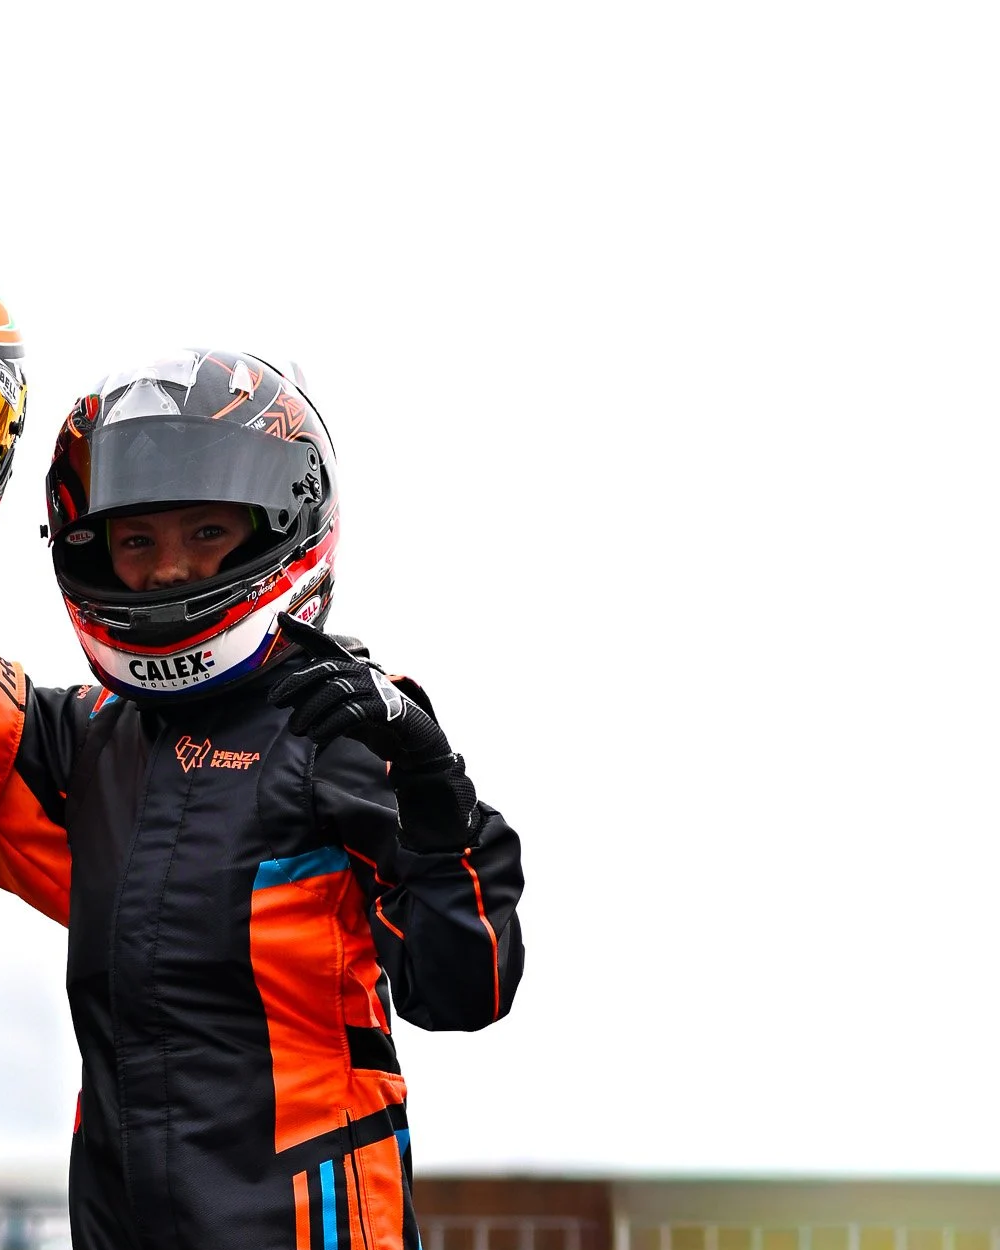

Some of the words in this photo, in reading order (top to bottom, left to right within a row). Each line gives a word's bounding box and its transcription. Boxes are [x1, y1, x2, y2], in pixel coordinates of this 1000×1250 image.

[0, 370, 17, 401] BELL
[128, 650, 208, 681] CALEX
[140, 672, 211, 688] HOLLAND
[212, 750, 260, 761] HENZA
[210, 758, 253, 770] KART
